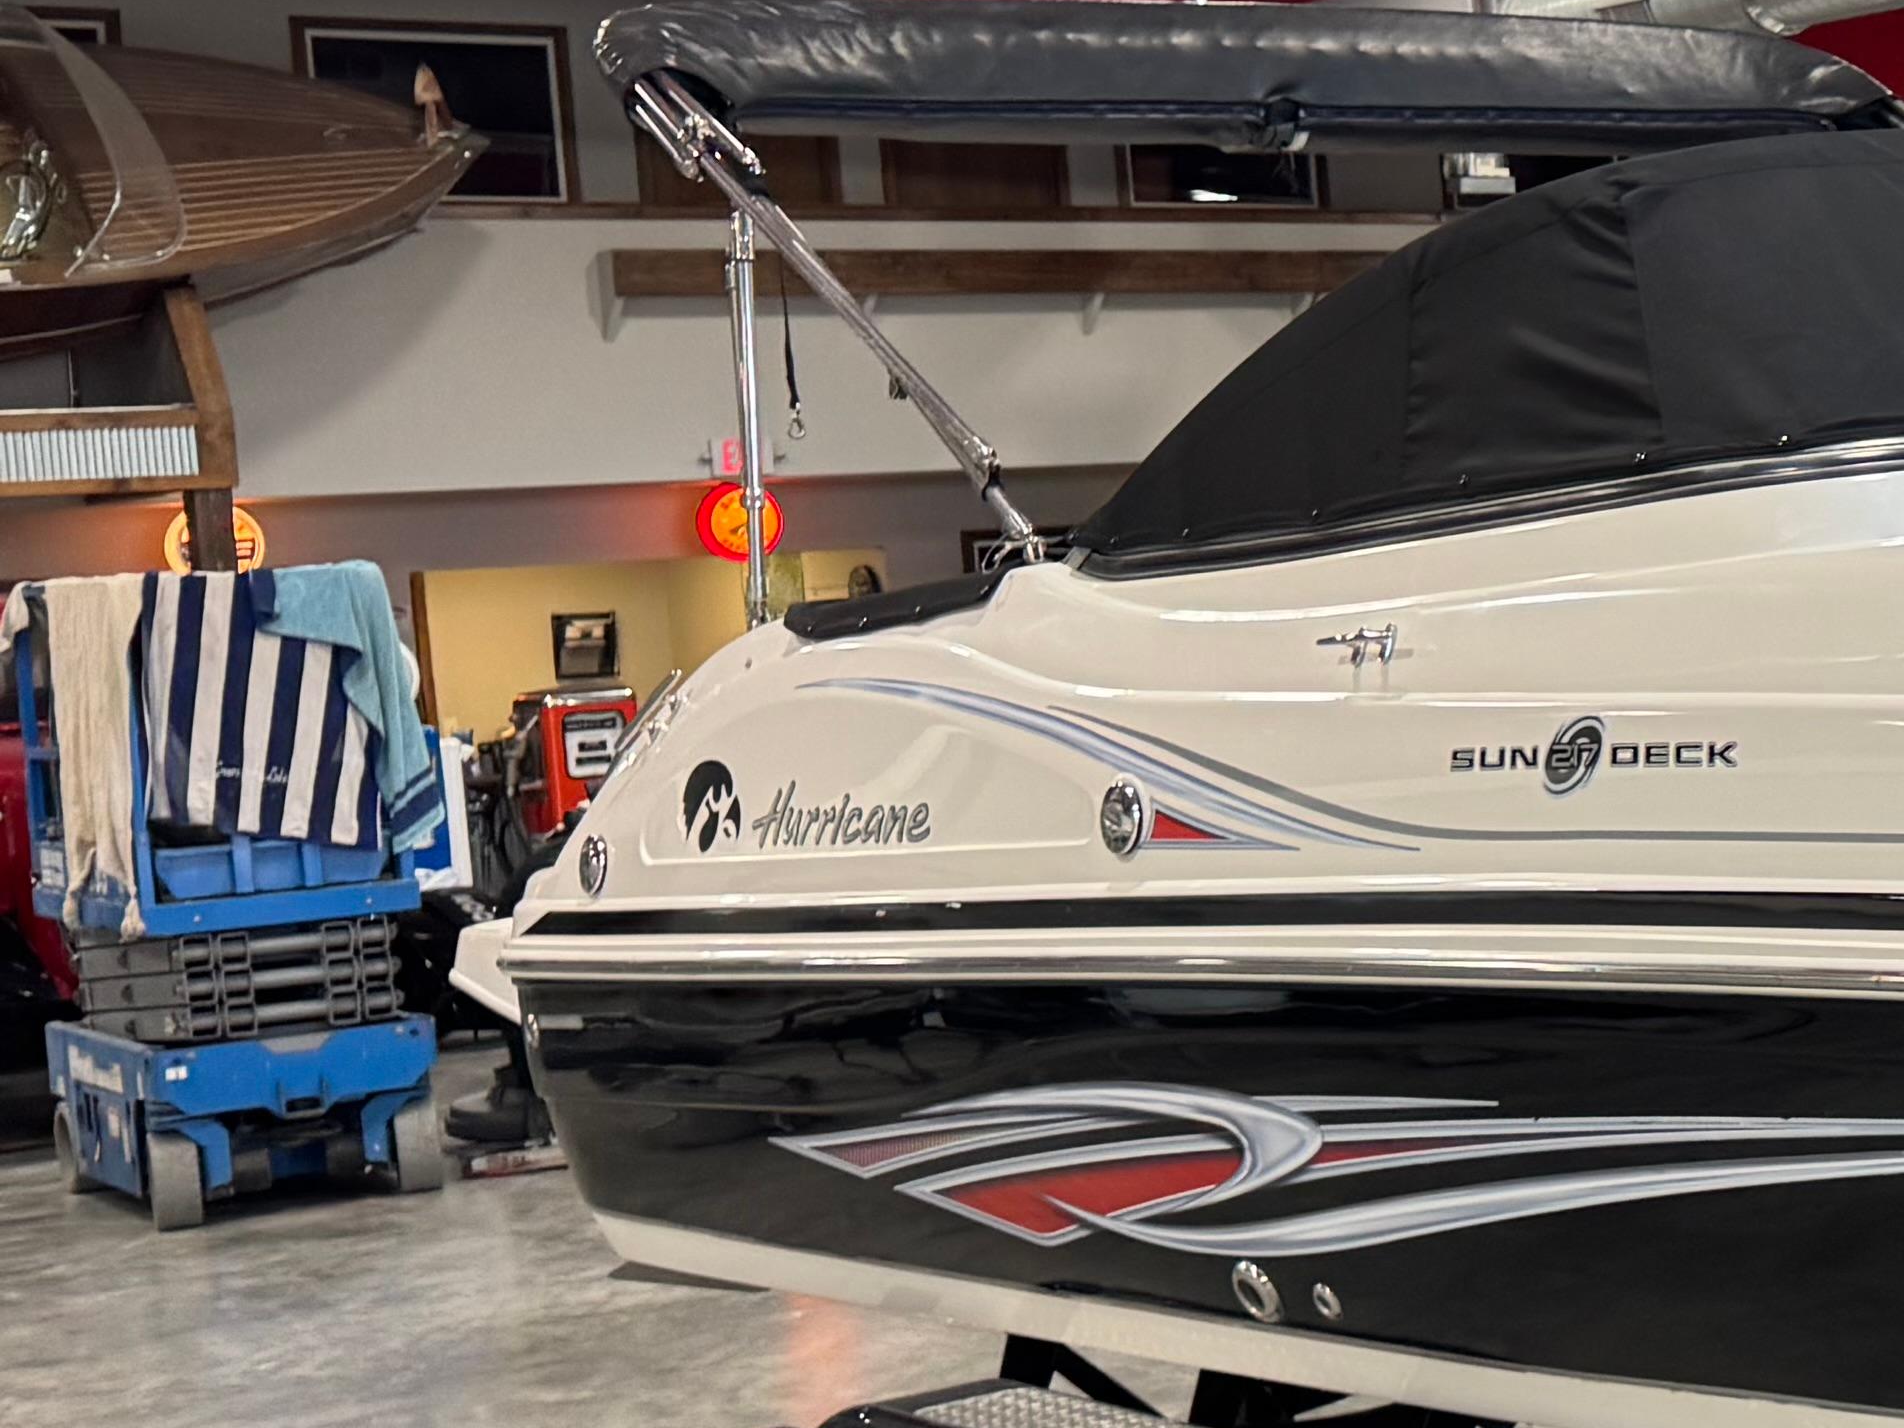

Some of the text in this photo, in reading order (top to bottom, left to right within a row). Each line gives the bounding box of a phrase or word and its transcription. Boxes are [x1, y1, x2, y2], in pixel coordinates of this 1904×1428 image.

[1450, 740, 1738, 772] SUN 217 DECK
[751, 779, 932, 850] Hurricane
